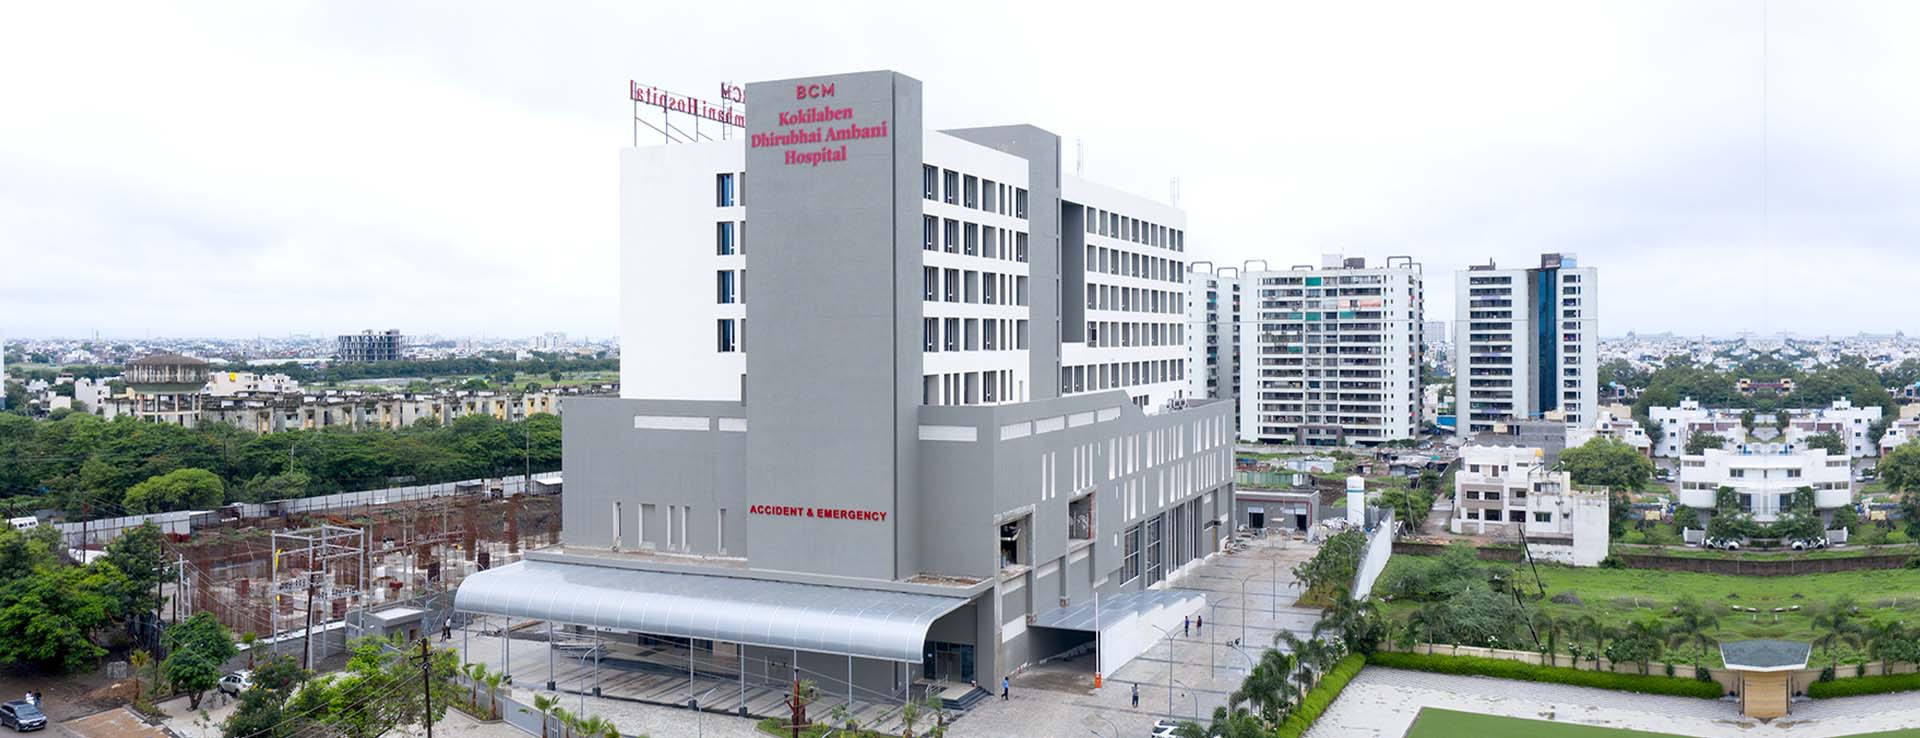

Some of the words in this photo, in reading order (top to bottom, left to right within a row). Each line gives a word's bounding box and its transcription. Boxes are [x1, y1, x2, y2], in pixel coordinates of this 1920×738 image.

[796, 83, 835, 100] BCM
[779, 105, 853, 126] Kokilaben
[751, 127, 822, 148] Dhirubhai
[825, 120, 888, 142] Ambani
[785, 144, 847, 167] Hospital
[750, 504, 804, 517] ACCIDENT
[806, 507, 814, 518] &
[816, 508, 887, 521] EMERGENCY
